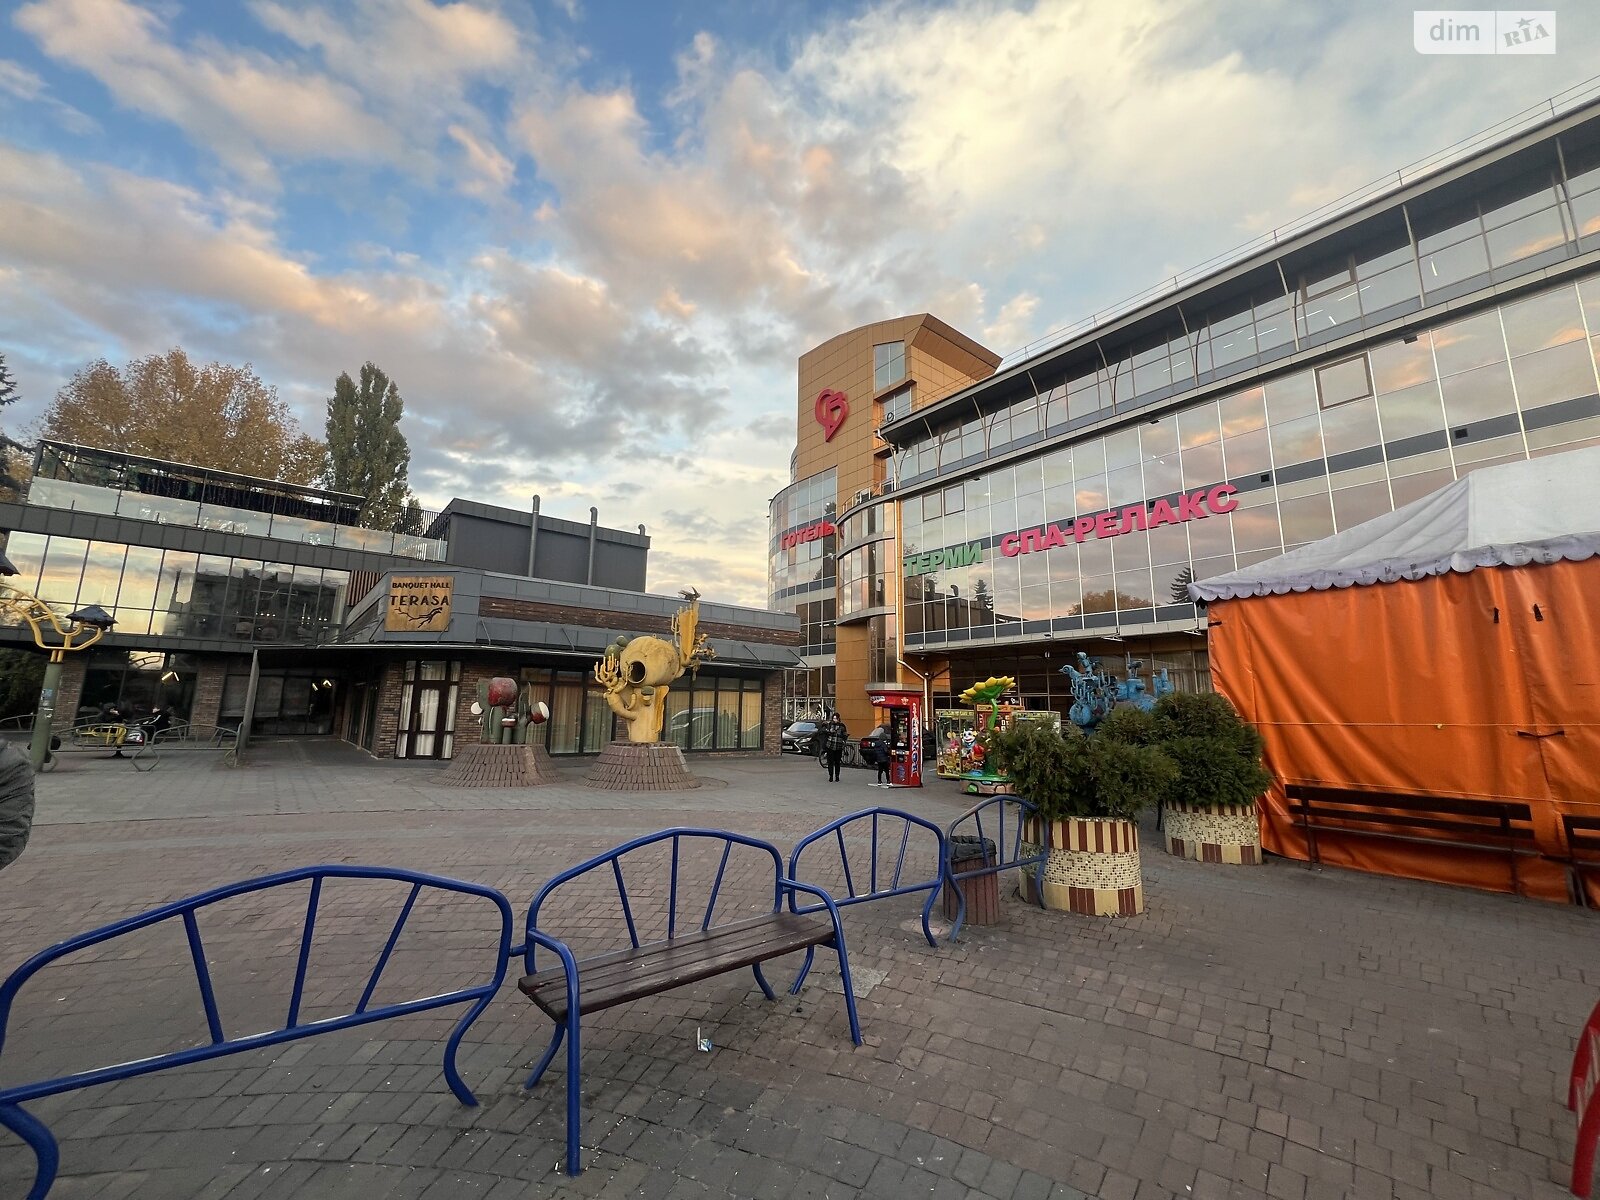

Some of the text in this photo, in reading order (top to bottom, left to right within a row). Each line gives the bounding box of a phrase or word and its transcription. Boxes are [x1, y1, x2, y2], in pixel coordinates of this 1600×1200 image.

[781, 521, 836, 551] ГОТЕЛЬ
[1000, 484, 1240, 557] СПА-РЕЛАКС
[903, 542, 983, 577] ТЕРМИ
[390, 595, 449, 606] TERASA
